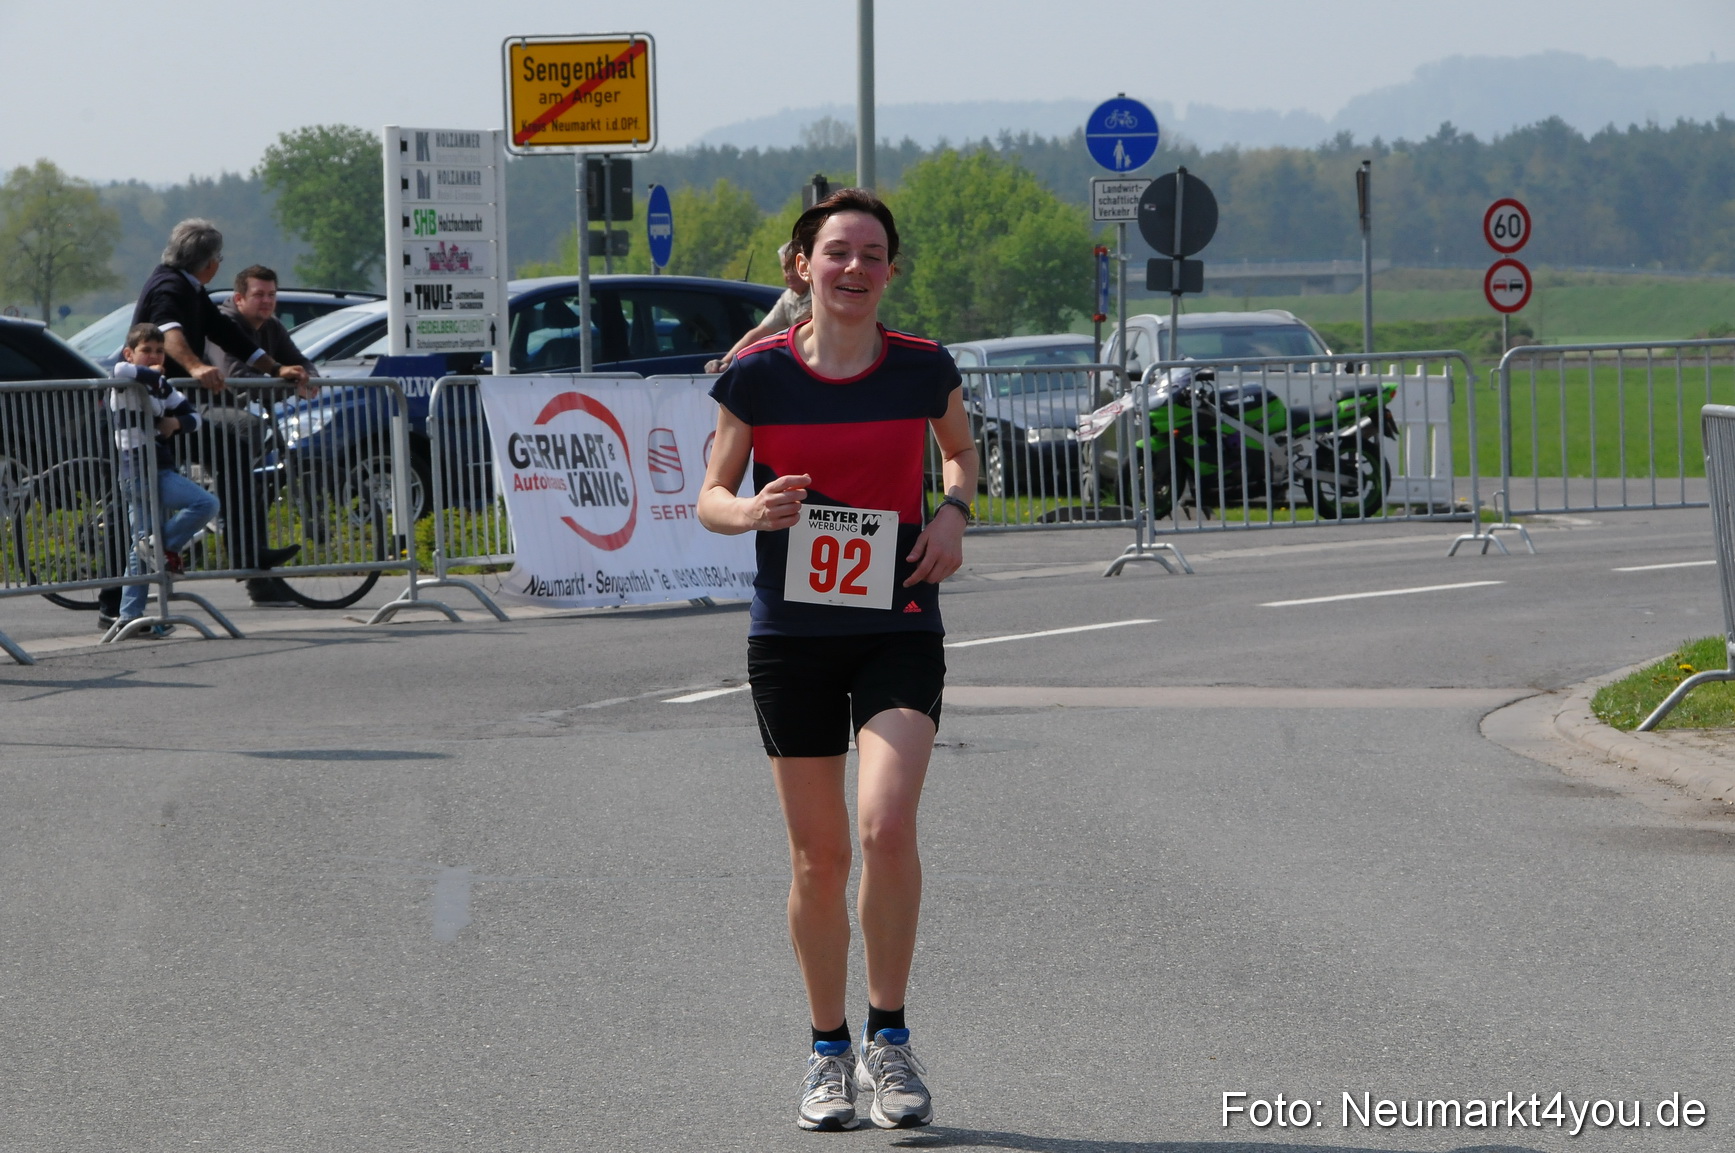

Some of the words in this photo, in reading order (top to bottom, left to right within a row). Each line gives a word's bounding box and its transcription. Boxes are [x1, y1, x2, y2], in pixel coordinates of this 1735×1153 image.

[523, 53, 636, 87] Sengenthal
[538, 92, 563, 104] am
[572, 88, 621, 107] Anger
[521, 119, 547, 132] Kreis
[551, 118, 602, 132] Neumarkt
[436, 132, 480, 148] HOLZAMMER
[437, 169, 481, 185] HOLZAMMER
[1102, 183, 1143, 194] Landwirt-
[413, 208, 437, 235] SHB
[438, 213, 482, 232] Holzfachmarkt
[1098, 207, 1130, 217] Verkehr
[1494, 213, 1521, 239] 60
[414, 284, 453, 310] THULE
[508, 432, 608, 469] GERHART
[607, 443, 615, 461] &
[513, 473, 567, 492] Autohaus
[567, 471, 629, 507] JÄNIG
[651, 504, 697, 520] SEAT
[808, 508, 858, 524] MEYER
[808, 520, 858, 533] WERBUNG
[809, 535, 872, 596] 92
[522, 573, 585, 597] Neumarkt
